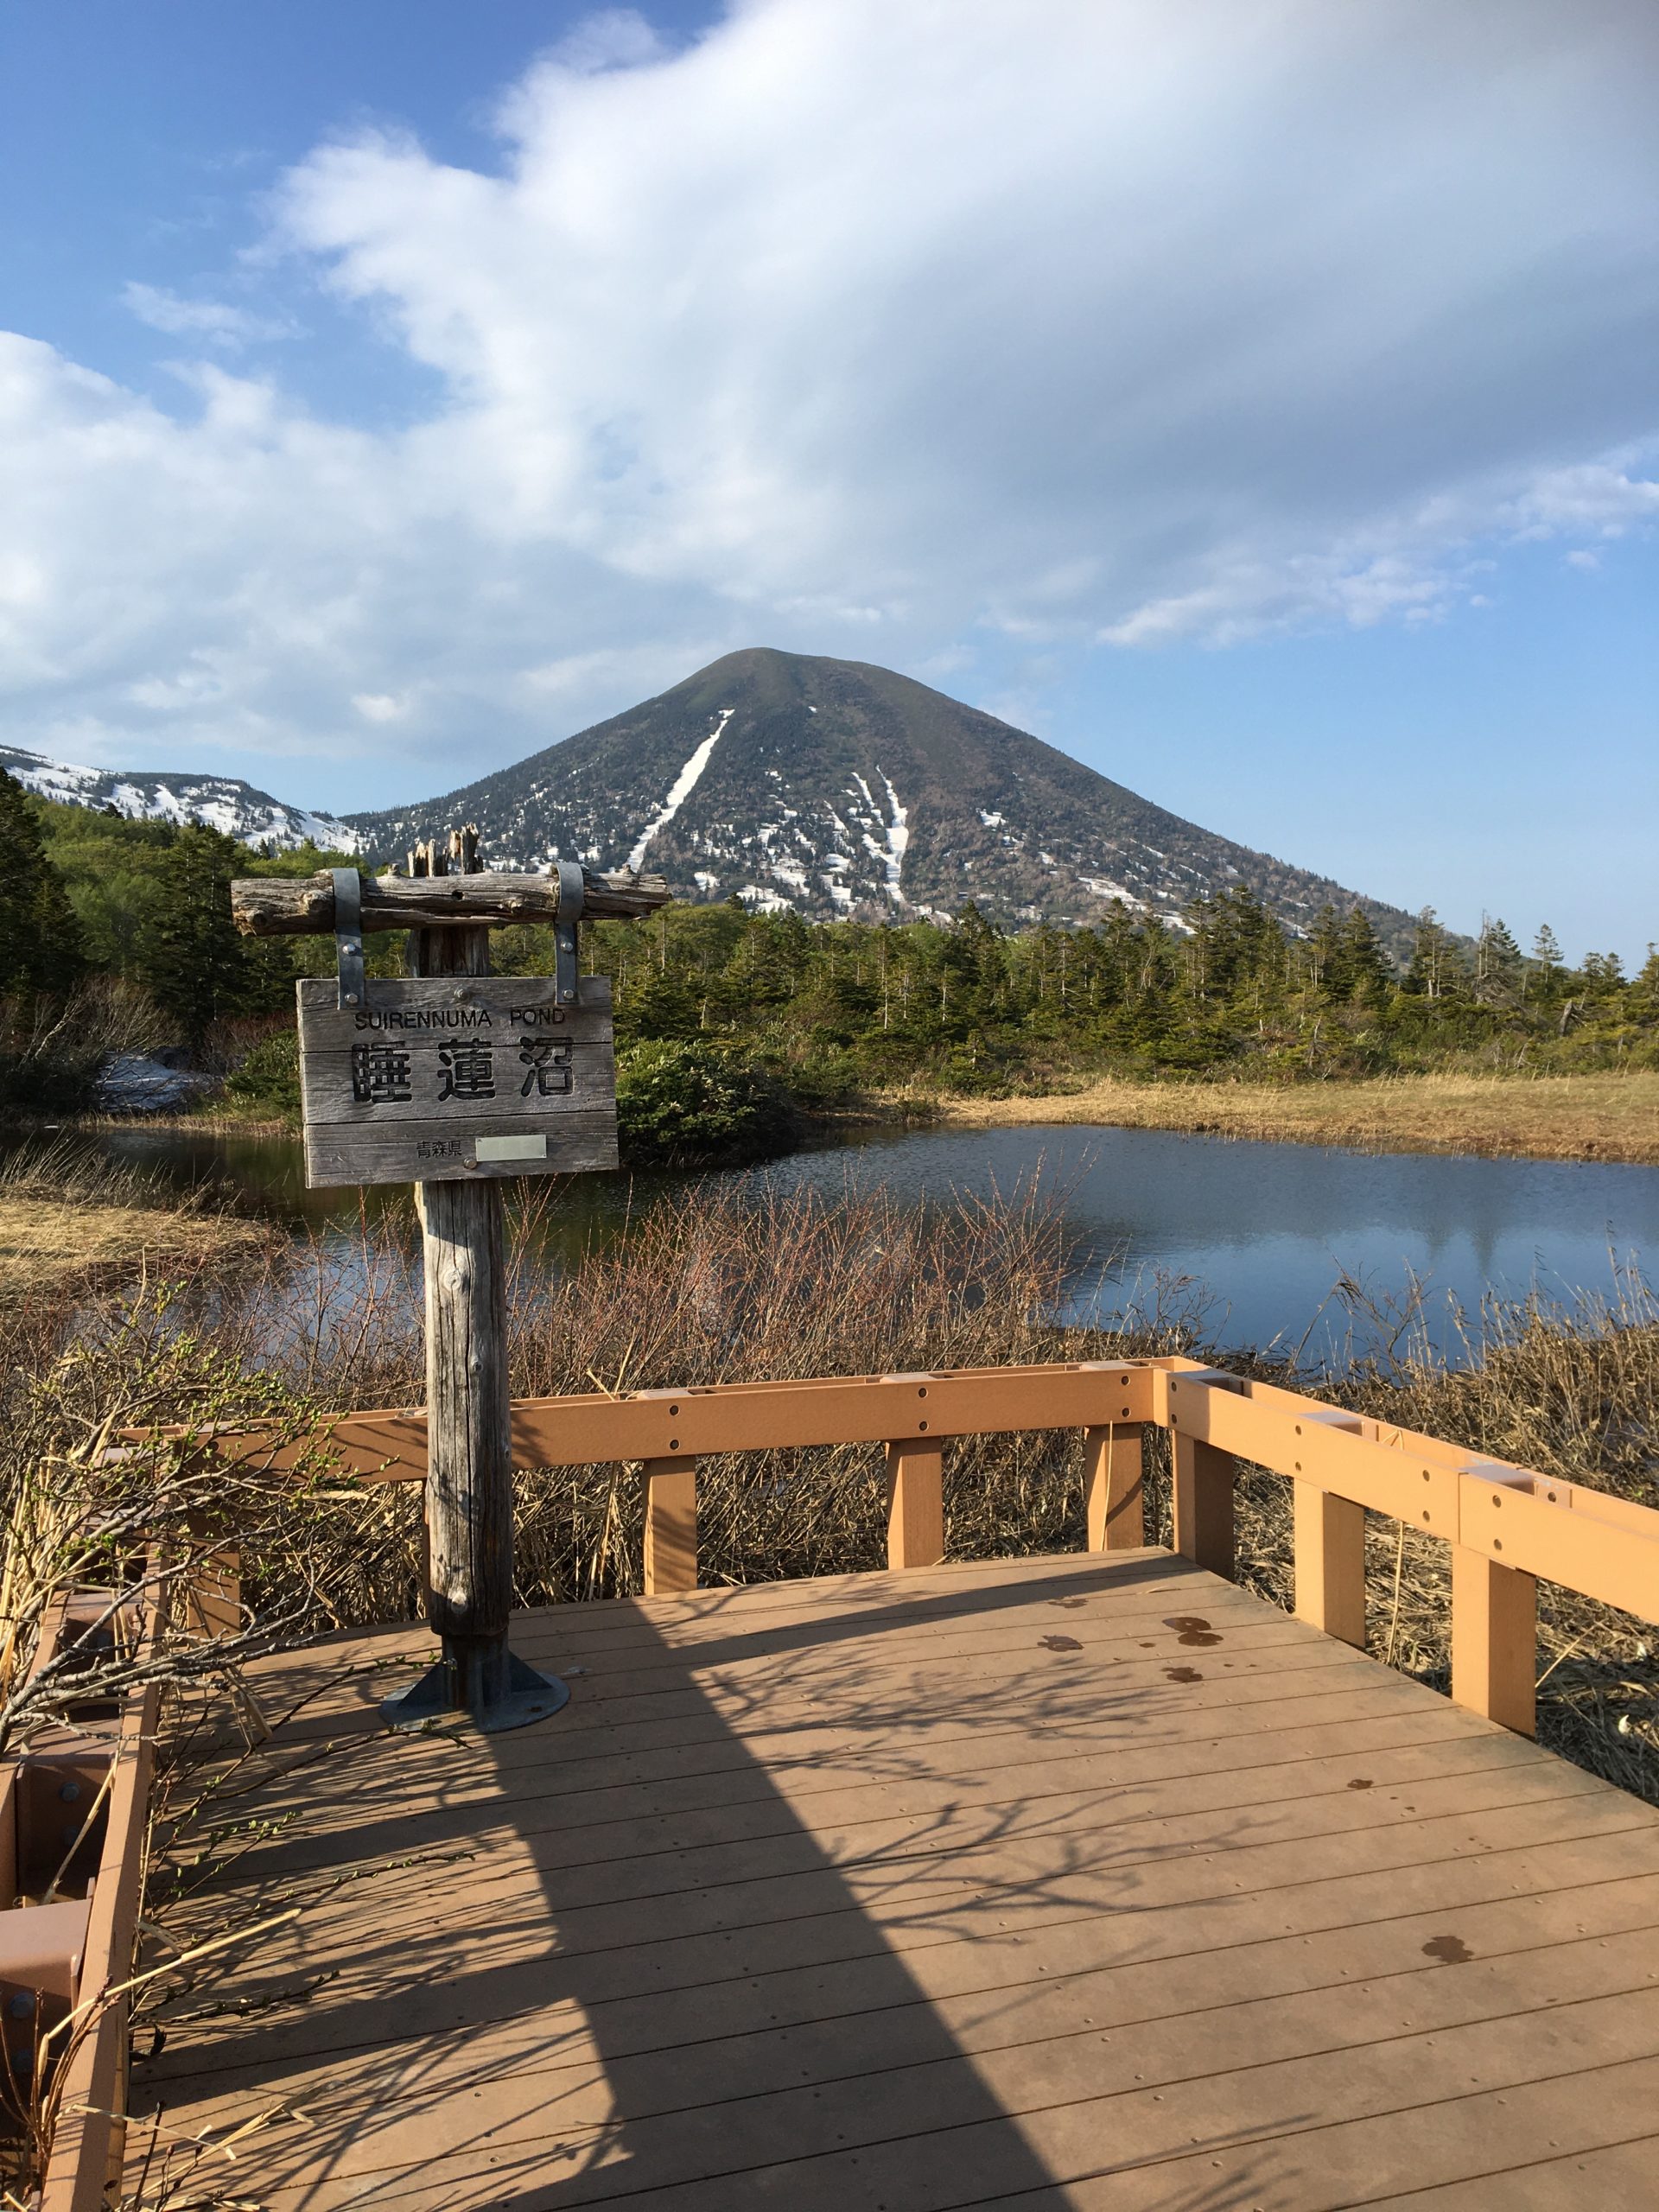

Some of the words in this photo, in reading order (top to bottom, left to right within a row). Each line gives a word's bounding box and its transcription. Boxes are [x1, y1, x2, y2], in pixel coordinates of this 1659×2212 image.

[354, 1009, 493, 1030] SUIRENNUMA
[510, 1007, 566, 1026] POND
[351, 1036, 575, 1103] 睡蓮沼
[416, 1140, 462, 1159] 青森県
